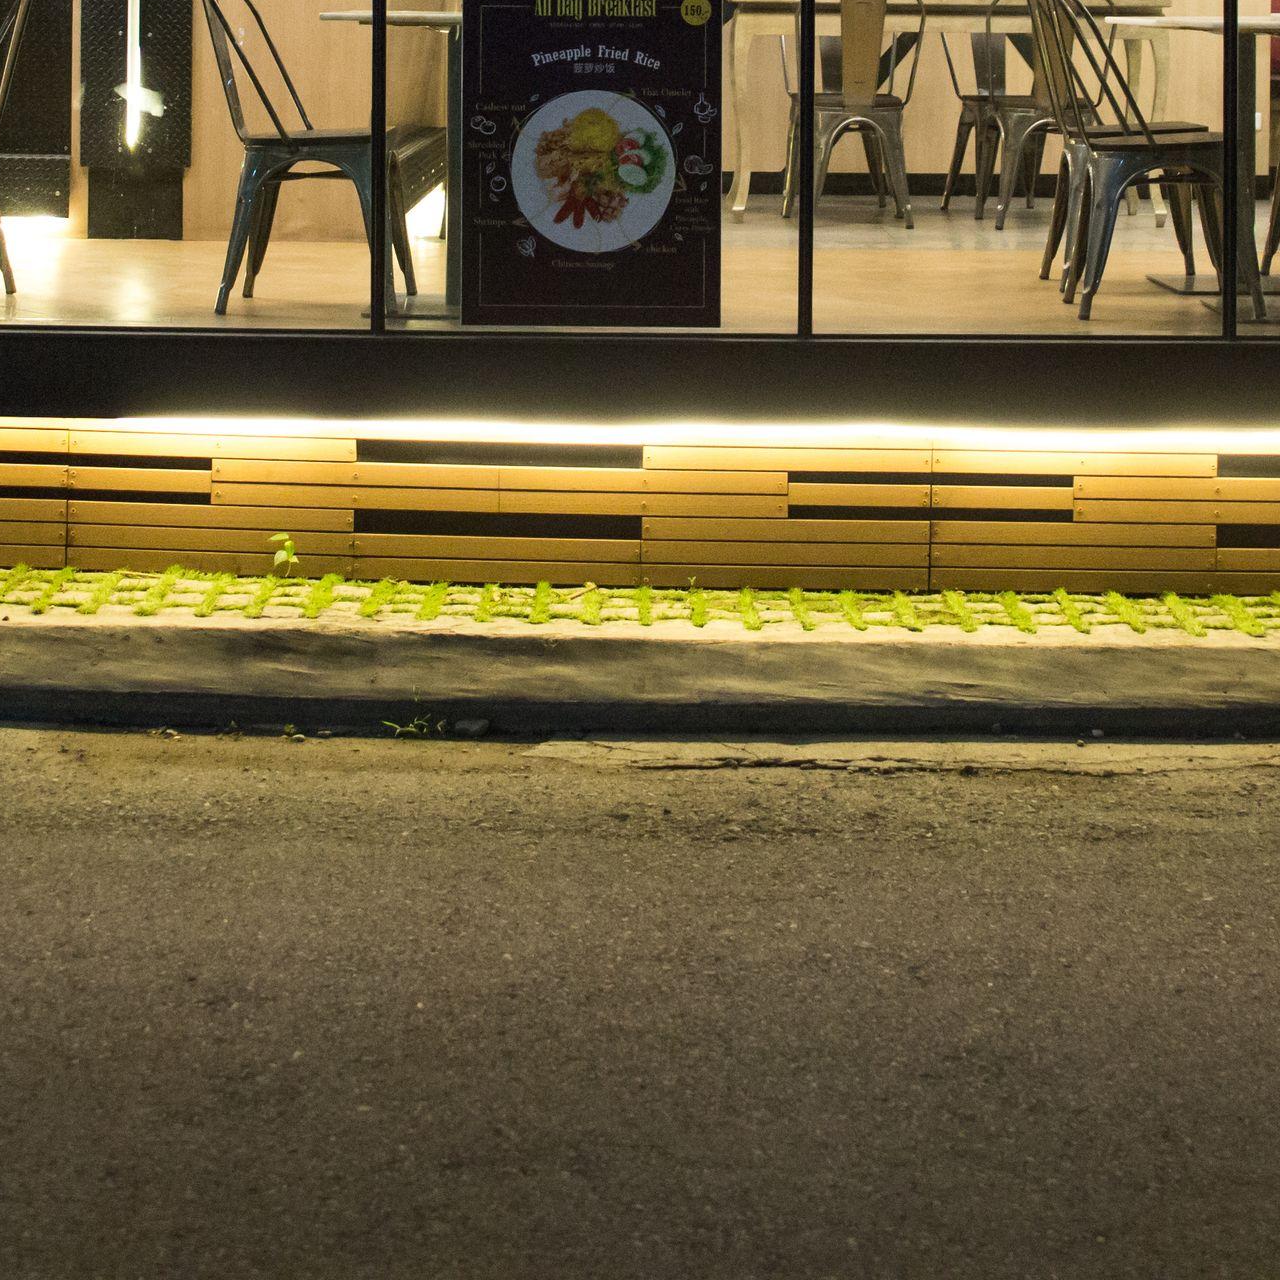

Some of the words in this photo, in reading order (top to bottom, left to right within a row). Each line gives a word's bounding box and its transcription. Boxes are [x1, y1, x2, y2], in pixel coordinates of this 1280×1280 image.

[531, 45, 591, 67] Pineapple
[598, 45, 629, 61] Fried
[634, 53, 661, 70] Rice
